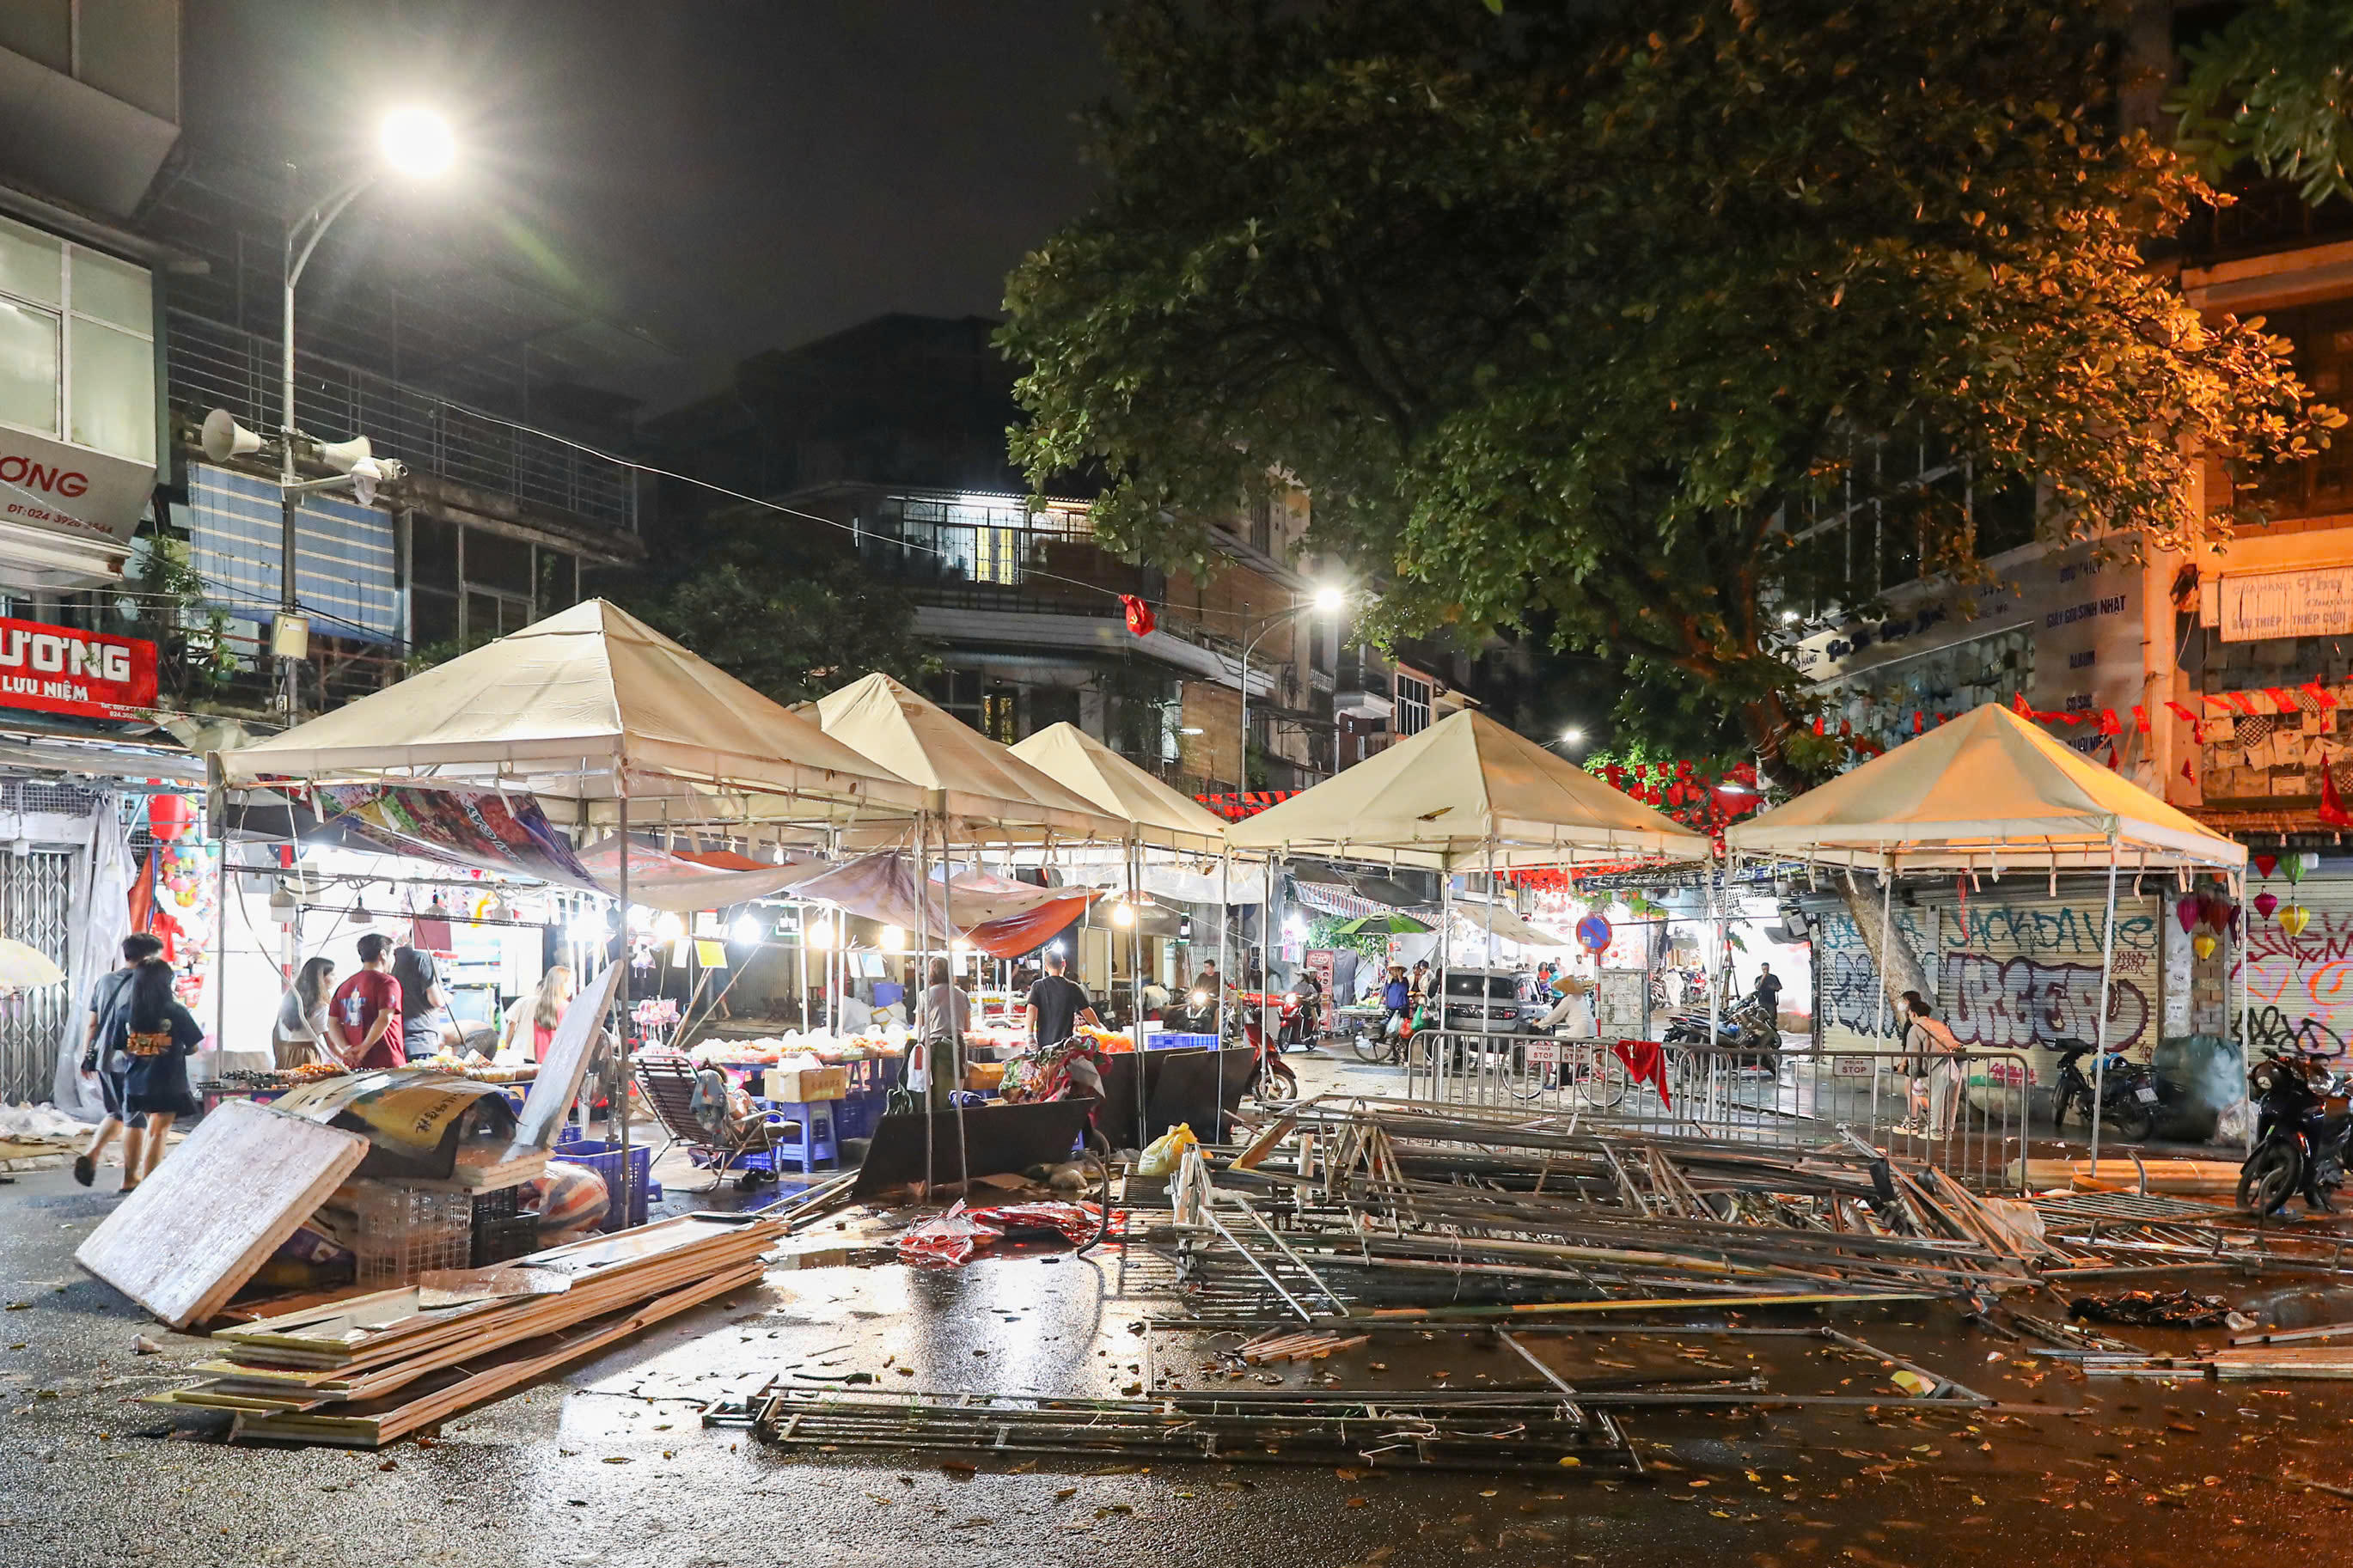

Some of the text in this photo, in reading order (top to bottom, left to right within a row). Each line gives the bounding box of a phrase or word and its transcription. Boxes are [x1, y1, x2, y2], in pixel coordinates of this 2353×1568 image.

[2100, 593, 2126, 615] NHẬT
[3, 674, 89, 702] LƯU NIỆM
